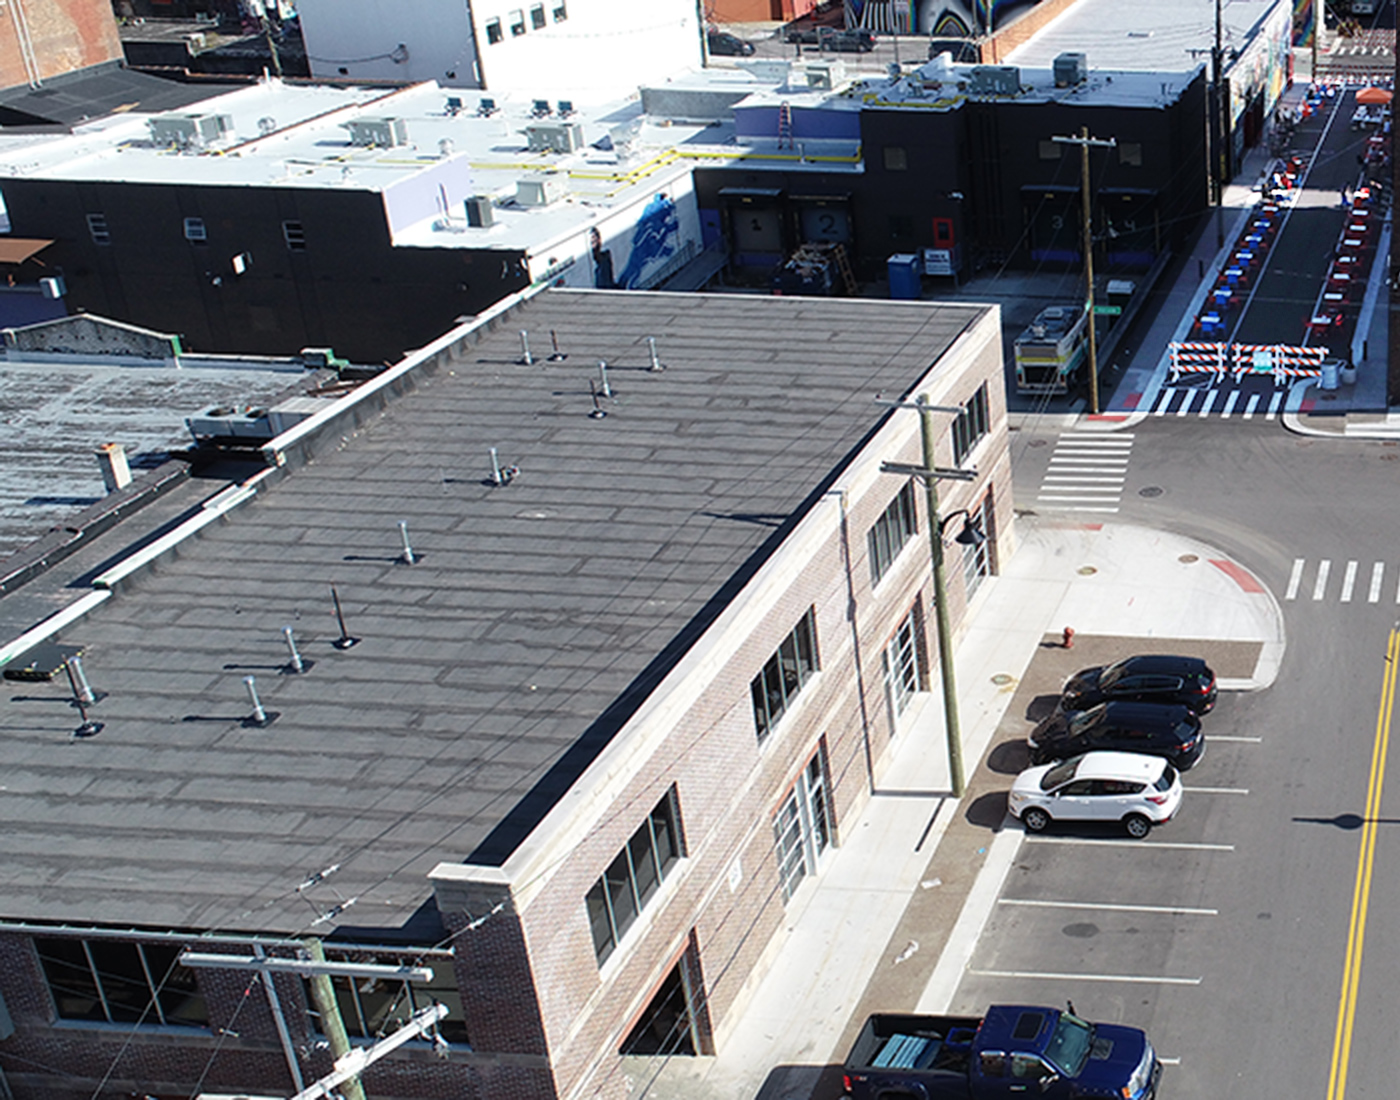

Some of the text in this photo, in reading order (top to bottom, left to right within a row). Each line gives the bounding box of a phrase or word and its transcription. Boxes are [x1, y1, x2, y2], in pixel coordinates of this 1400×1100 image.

[751, 218, 762, 231] 1
[818, 214, 839, 235] 2
[1051, 215, 1063, 230] 3
